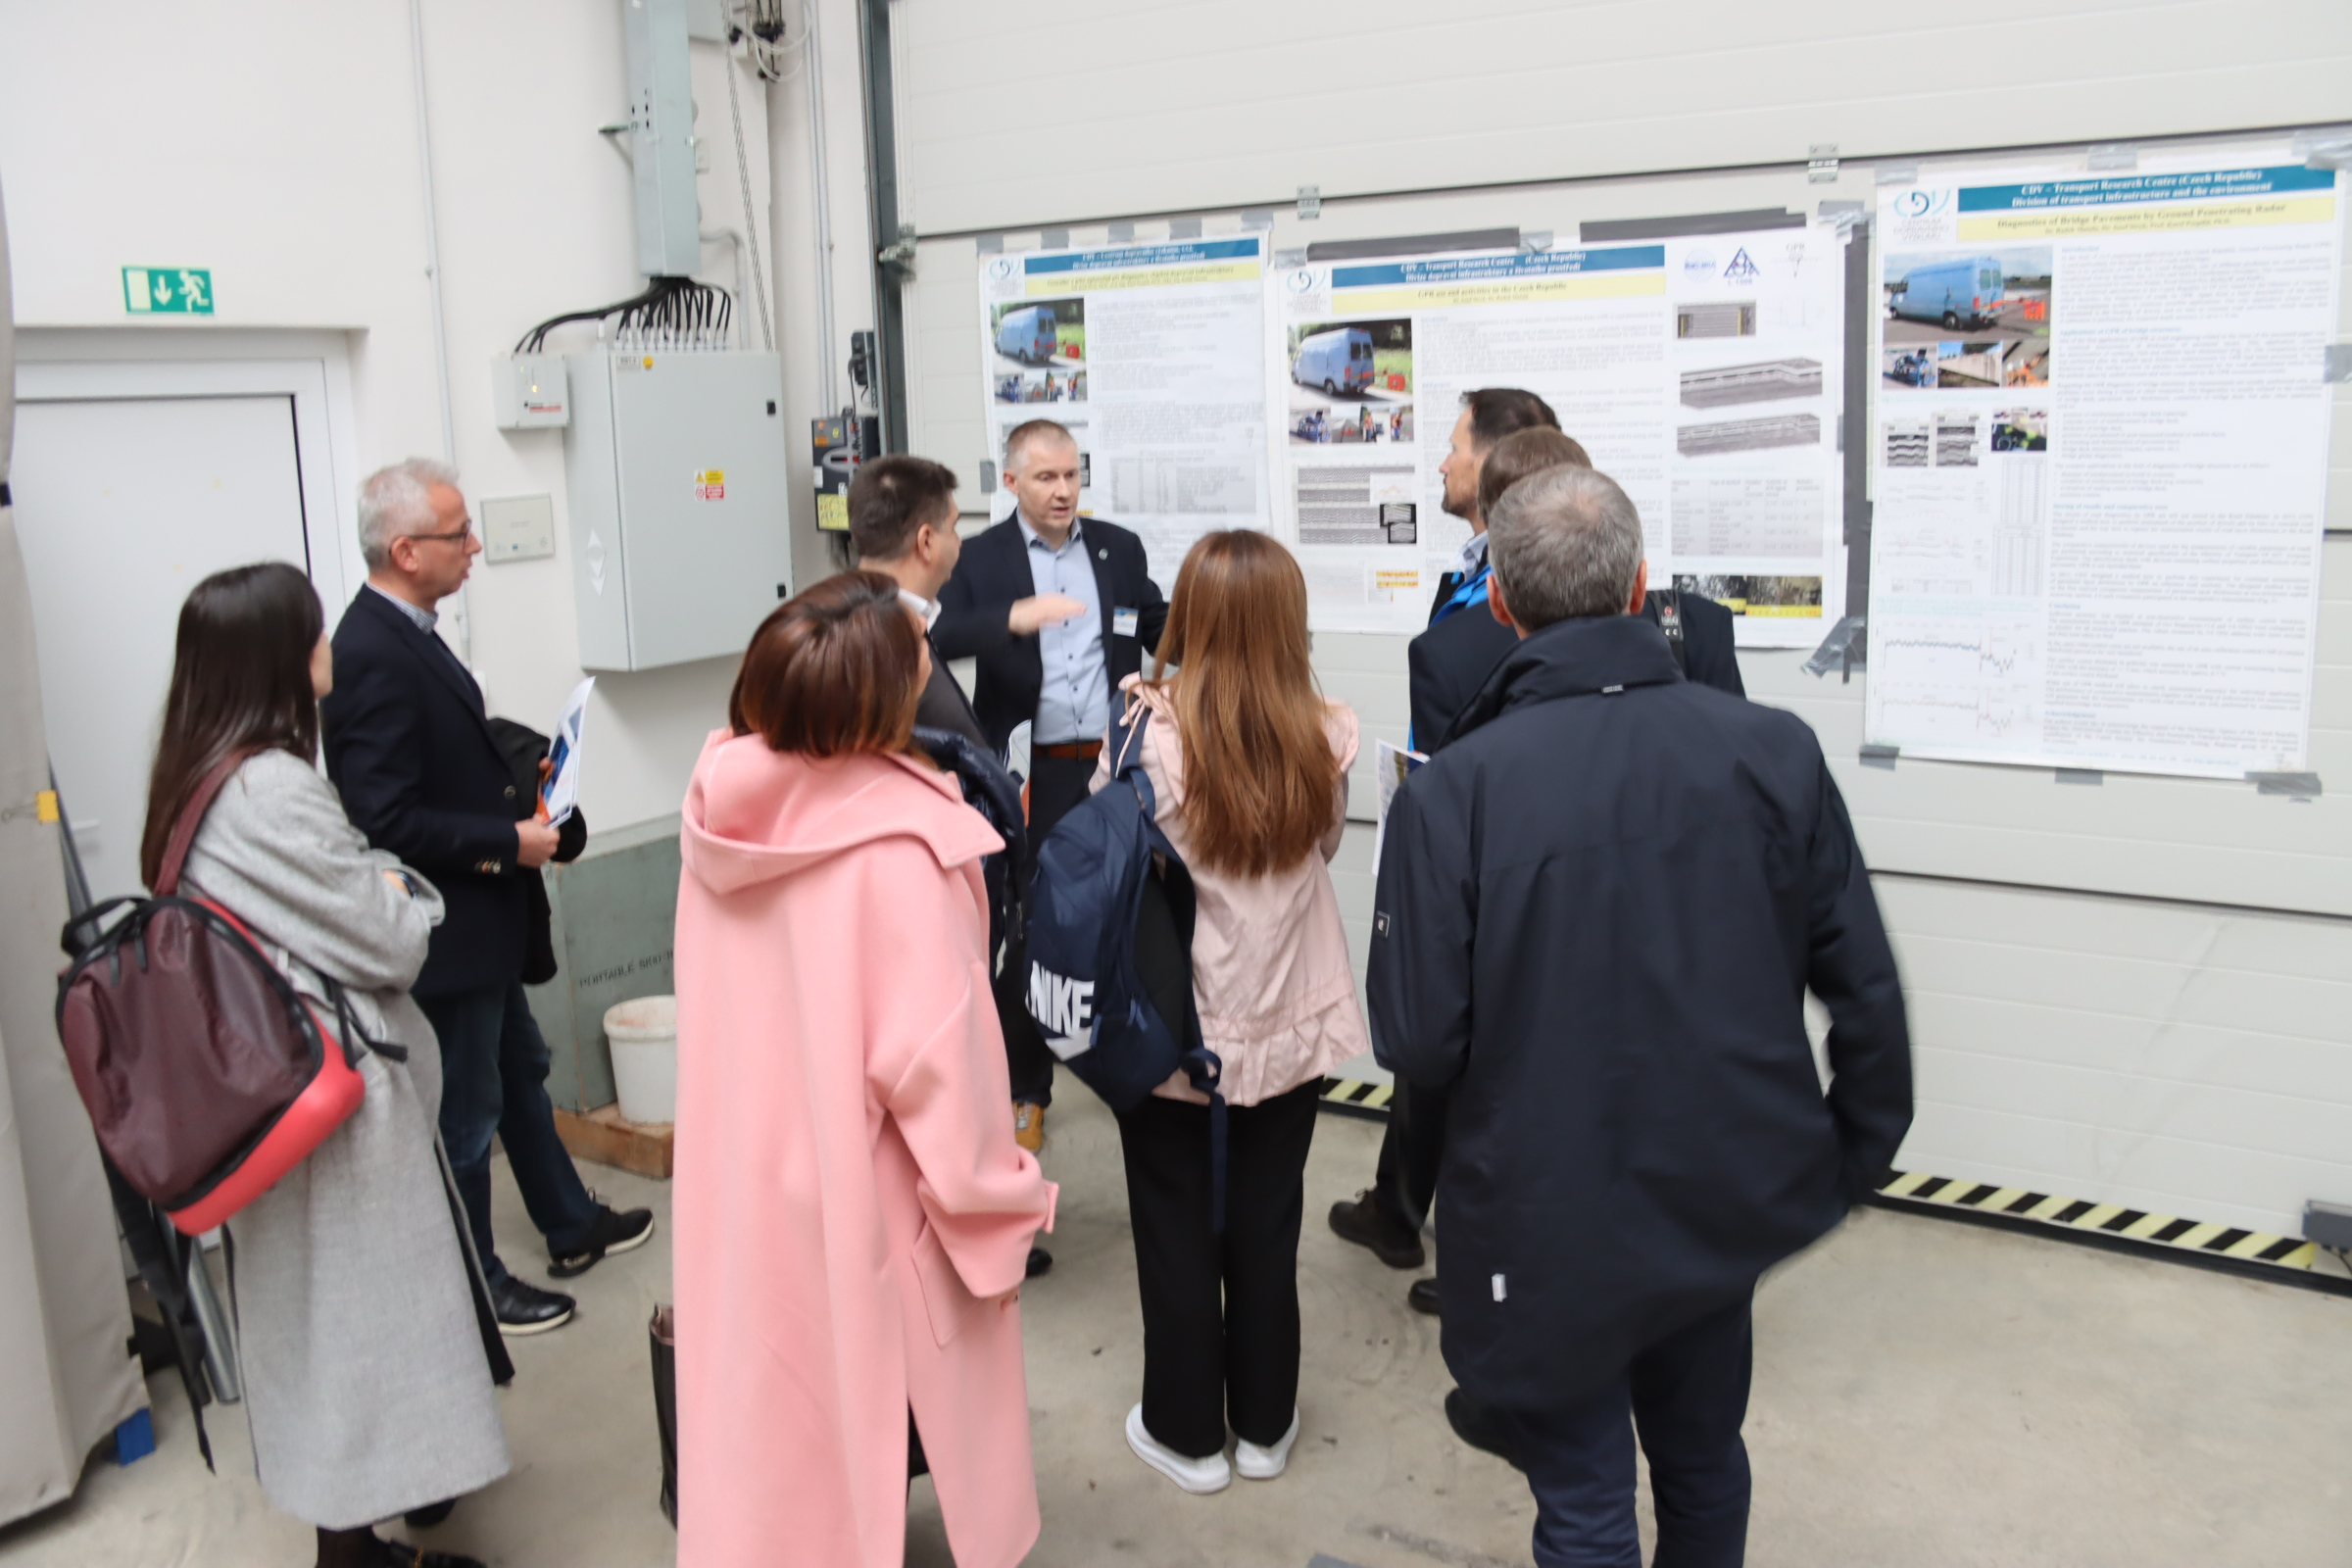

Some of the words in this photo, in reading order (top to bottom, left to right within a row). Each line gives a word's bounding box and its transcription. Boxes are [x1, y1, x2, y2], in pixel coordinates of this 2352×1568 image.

[2012, 196, 2047, 208] Division
[2049, 194, 2060, 205] of
[2061, 192, 2104, 205] transport
[2105, 186, 2171, 203] infrastructure
[2172, 185, 2191, 198] and
[2192, 185, 2209, 196] the
[2209, 180, 2274, 195] environment
[2021, 184, 2044, 196] CDV
[2053, 180, 2099, 194] Transport
[2101, 177, 2143, 190] Research
[2144, 176, 2178, 188] Centre
[2179, 173, 2213, 186] (Czech
[2214, 170, 2263, 183] Republic)
[1997, 218, 2047, 229] Diagnostics
[2048, 217, 2059, 225] of
[2060, 215, 2090, 226] Bridge
[2092, 212, 2141, 223] Pavements
[2143, 211, 2154, 222] by
[2157, 209, 2194, 220] Ground
[2197, 205, 2252, 218] Penetrating
[2255, 203, 2287, 214] Radar
[1426, 262, 1456, 271] Transport
[1459, 260, 1490, 269] Research
[1491, 258, 1515, 268] Centre
[579, 960, 635, 988] PORTABLE
[1029, 959, 1095, 1040] NIKE
